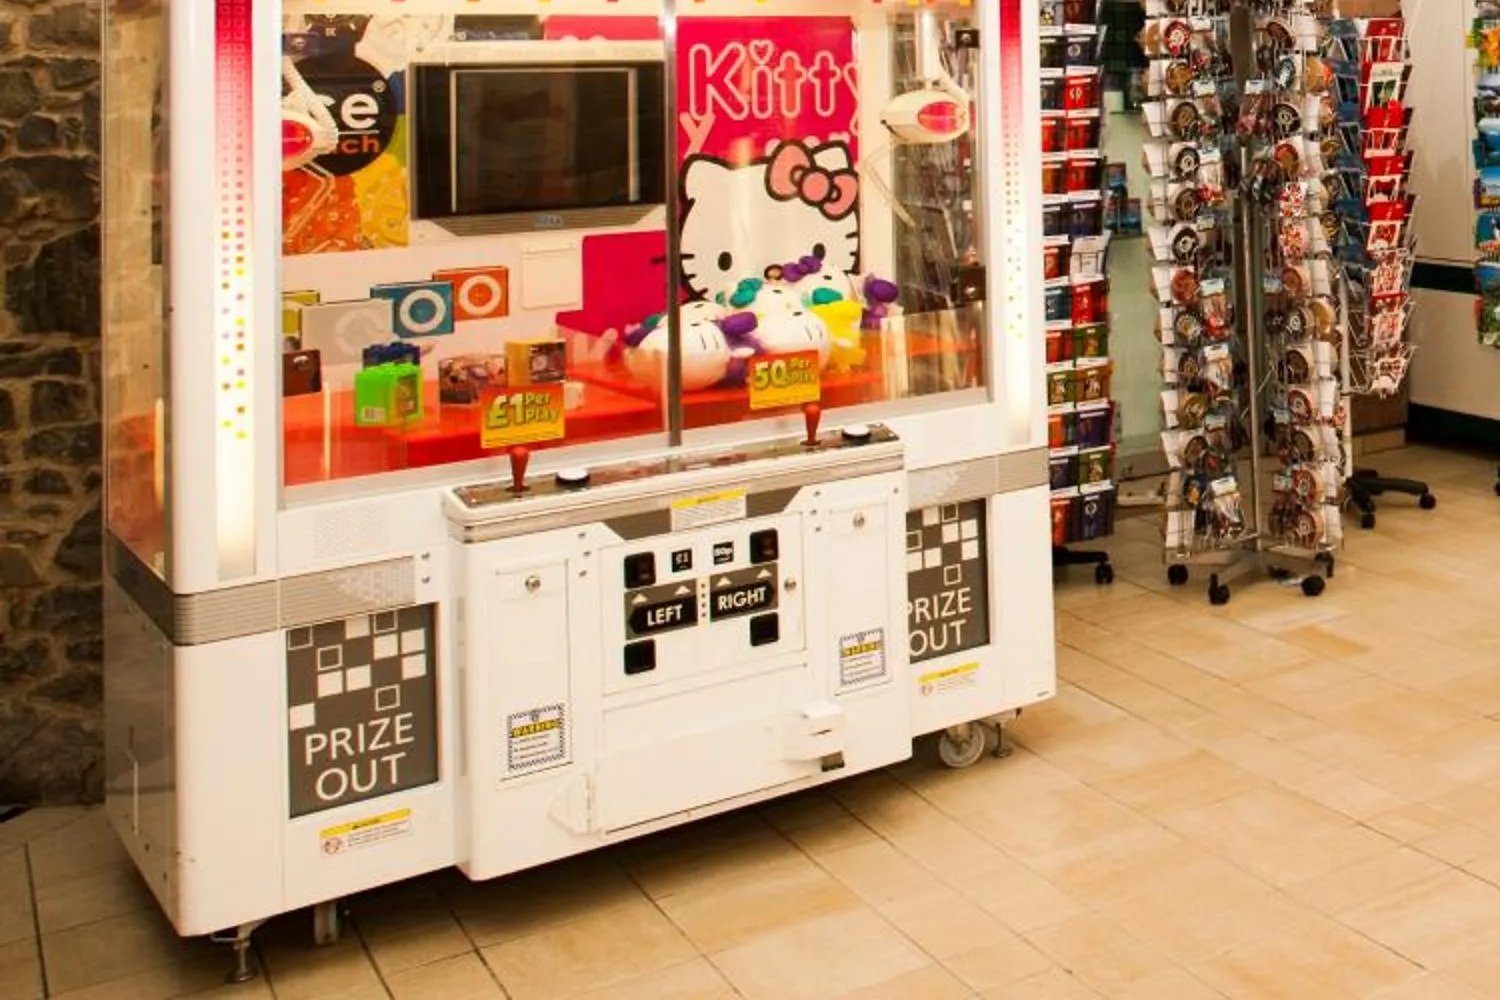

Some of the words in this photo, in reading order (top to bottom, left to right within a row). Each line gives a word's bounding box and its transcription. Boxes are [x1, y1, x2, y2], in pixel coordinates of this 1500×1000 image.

[487, 393, 525, 429] £1
[646, 604, 684, 627] LEFT
[717, 586, 767, 612] RIGHT
[907, 619, 967, 657] OUT
[304, 711, 416, 767] PRIZE
[314, 751, 407, 802] OUT
